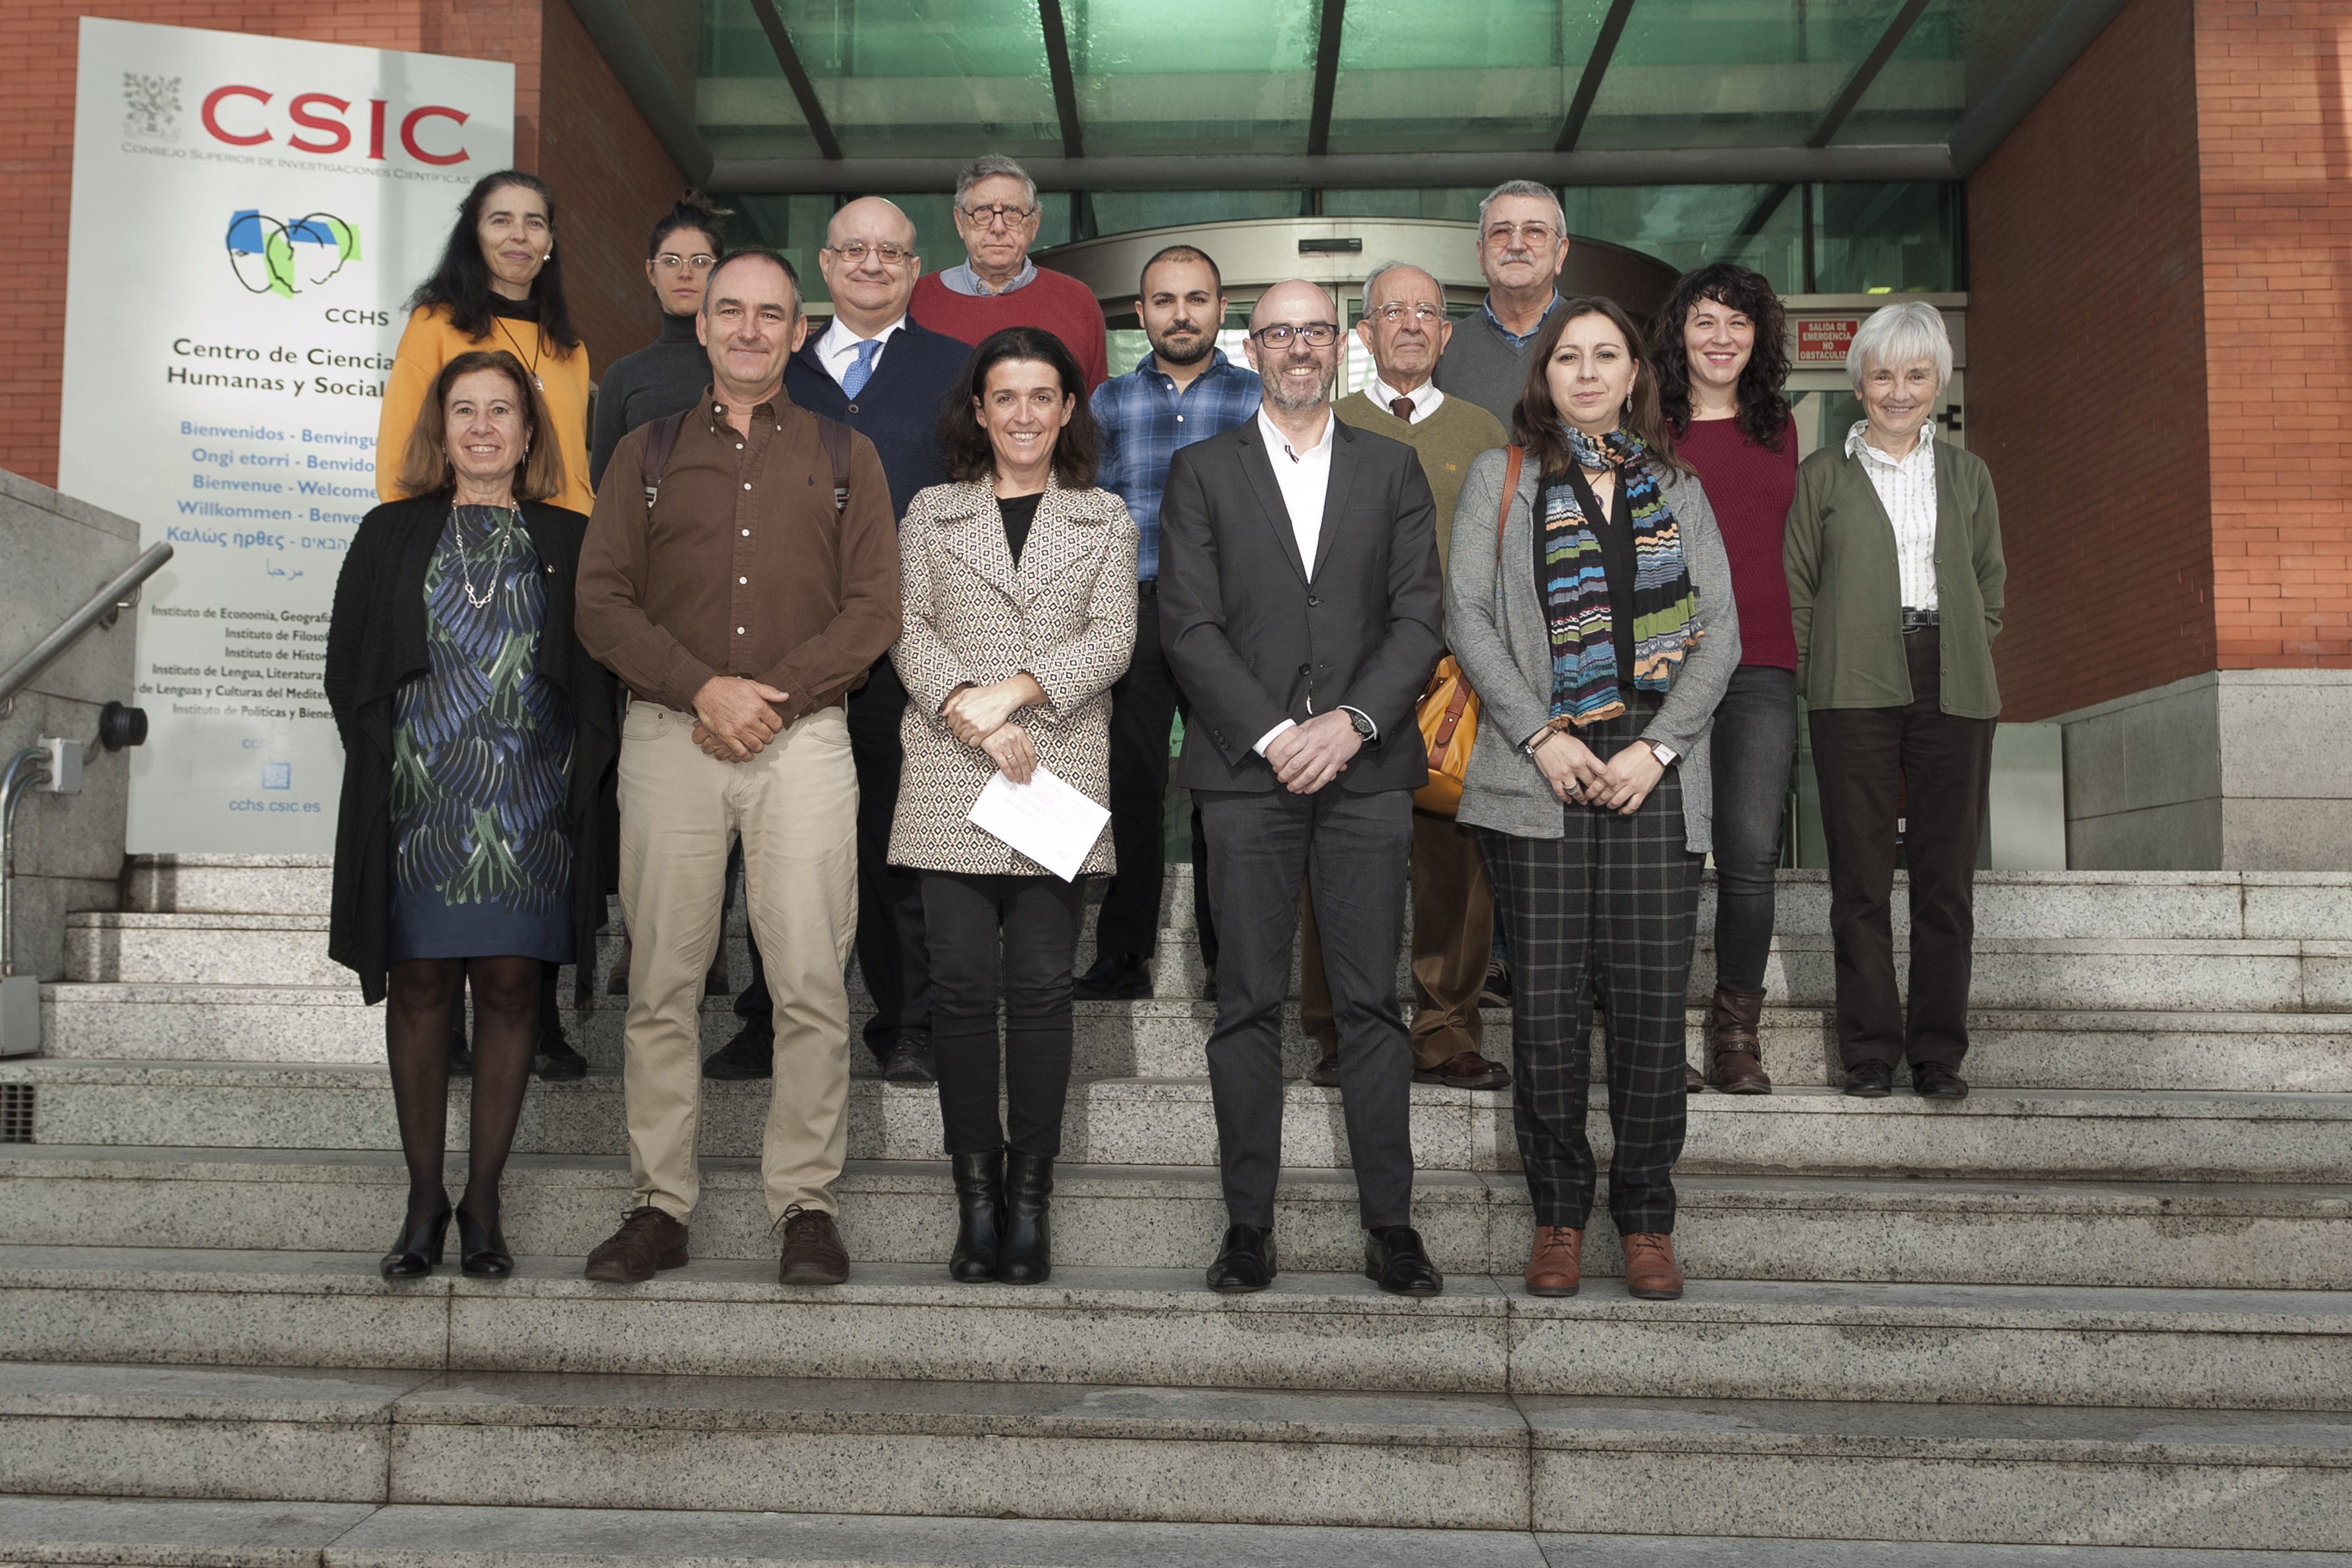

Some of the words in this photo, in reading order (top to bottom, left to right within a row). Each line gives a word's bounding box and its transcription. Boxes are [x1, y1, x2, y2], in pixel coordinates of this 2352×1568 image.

[201, 84, 471, 165] CSIC
[121, 142, 186, 159] CONSEJO
[189, 148, 254, 165] SUPERIOR
[325, 308, 389, 326] CCHS
[1809, 322, 1835, 331] SALIDA
[1837, 322, 1847, 331] DE
[173, 338, 260, 361] Centro
[269, 346, 297, 363] de
[1823, 341, 1834, 350] NO
[167, 366, 284, 391] Humanas
[293, 379, 305, 397] y
[314, 377, 384, 397] Social
[180, 421, 284, 441] Bienvenidos
[191, 447, 233, 467] Ongi
[240, 452, 289, 467] etorri
[307, 455, 374, 472] Benvido
[192, 475, 282, 494] Bienvenue
[297, 480, 379, 499] Welcome
[178, 500, 292, 520] Willkommen
[152, 605, 200, 618] Instituto
[203, 607, 216, 618] de
[225, 627, 273, 640] Instituto
[275, 629, 289, 640] de
[225, 647, 273, 659] Instituto
[275, 649, 289, 660] de
[152, 663, 200, 675] Instituto
[204, 665, 217, 676] de
[221, 665, 264, 680] Lengua,
[267, 668, 322, 680] Literatura
[139, 683, 152, 694] de
[157, 683, 202, 697] Lenguas
[205, 688, 211, 698] y
[215, 685, 262, 697] Culturas
[266, 687, 283, 699] del
[173, 703, 221, 715] Instituto
[223, 705, 237, 716] de
[289, 710, 295, 721] y
[228, 798, 321, 812] cchs.csic.es
